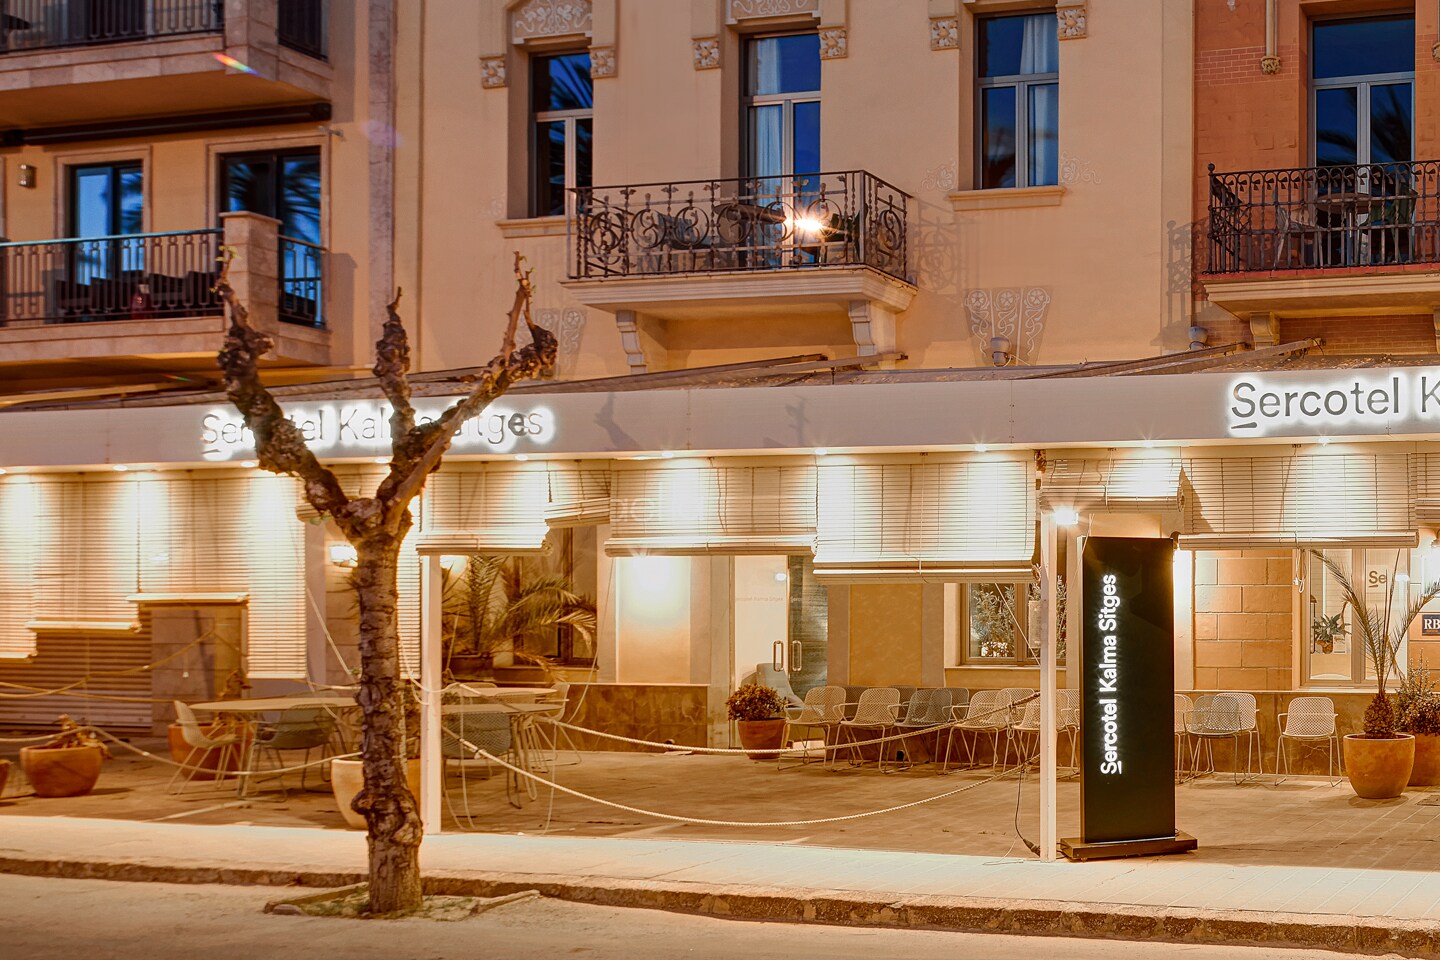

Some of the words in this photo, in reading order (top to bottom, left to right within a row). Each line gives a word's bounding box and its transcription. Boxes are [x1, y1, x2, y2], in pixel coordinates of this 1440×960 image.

[1231, 376, 1400, 429] Sercotel
[1099, 574, 1121, 632] Sitges
[1423, 618, 1440, 630] RB
[1099, 635, 1117, 692] Kalma
[1099, 698, 1122, 774] Sercotel
